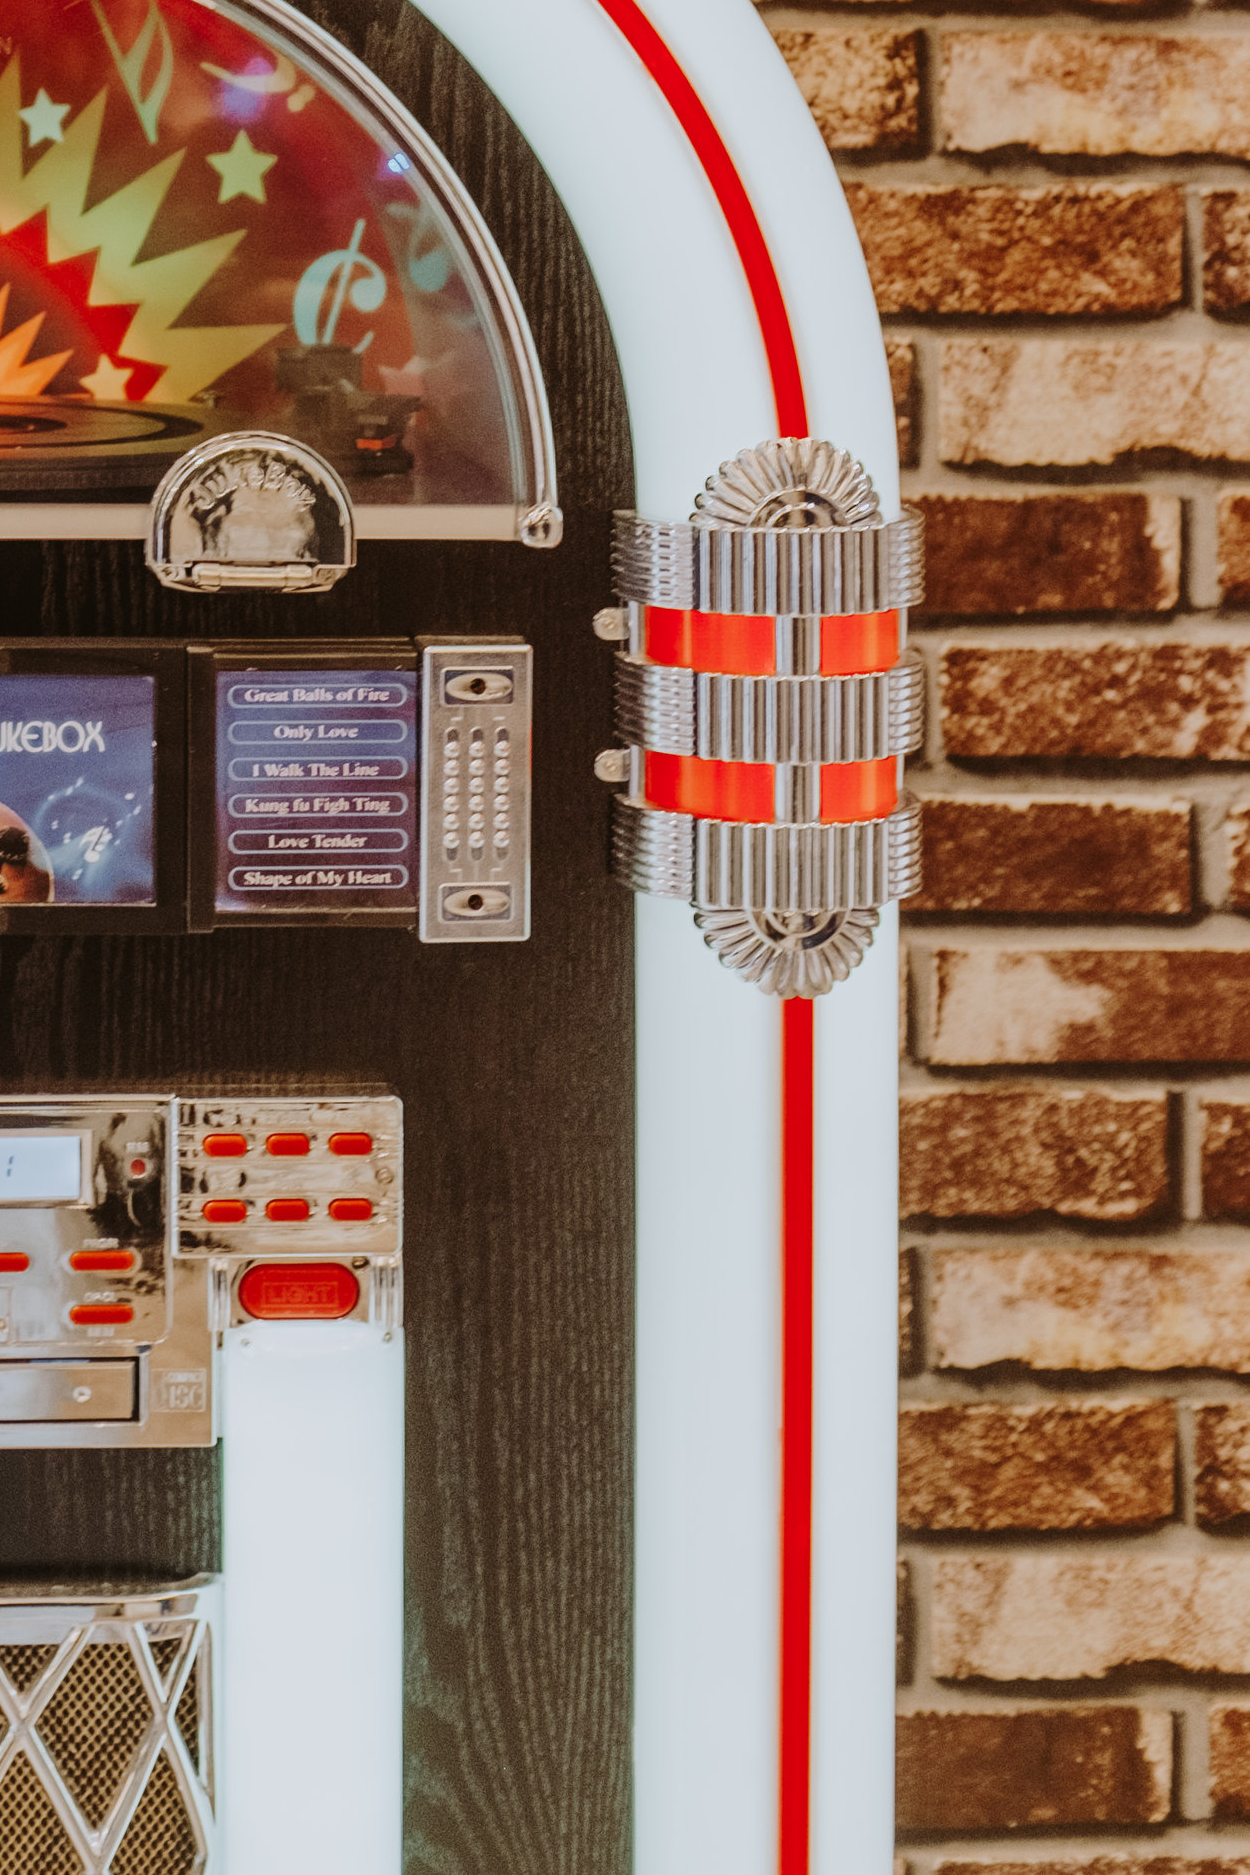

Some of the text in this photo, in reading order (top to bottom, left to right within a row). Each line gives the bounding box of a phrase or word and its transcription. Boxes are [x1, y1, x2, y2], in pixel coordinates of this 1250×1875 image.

[244, 688, 390, 702] Great Balls of Fire
[273, 725, 359, 741] Only Love
[252, 762, 380, 778] I Walk The Line
[245, 797, 391, 814] Kung fu Figh Ting
[268, 834, 368, 848] Love Tender
[243, 871, 392, 888] Shape of My Heart
